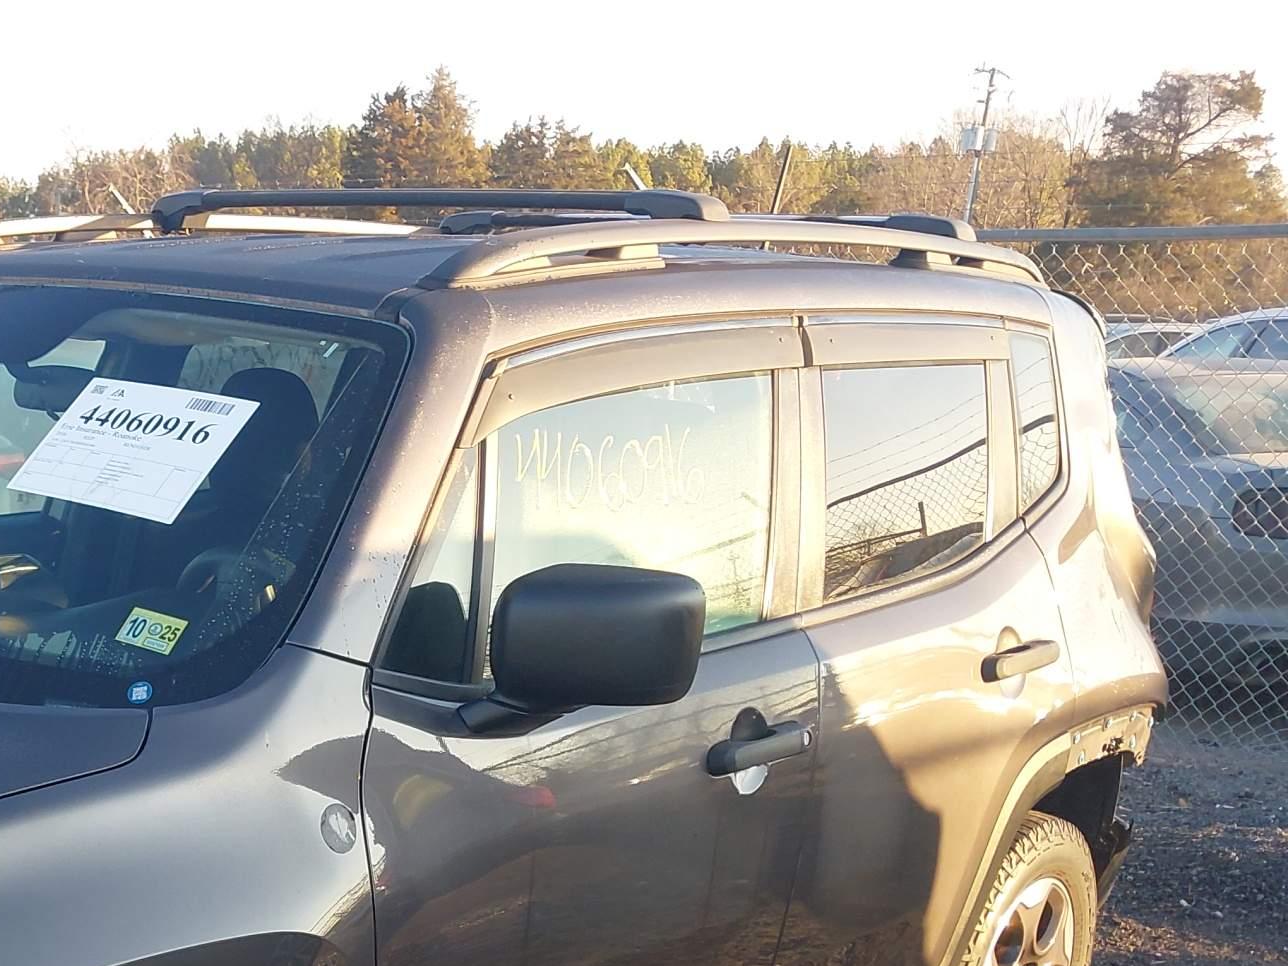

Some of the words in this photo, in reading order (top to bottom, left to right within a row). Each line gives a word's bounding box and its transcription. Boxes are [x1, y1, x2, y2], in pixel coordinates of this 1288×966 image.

[80, 405, 218, 444] 44060916
[515, 424, 705, 511] 44060916
[126, 616, 148, 639] 10
[159, 625, 181, 642] 25
